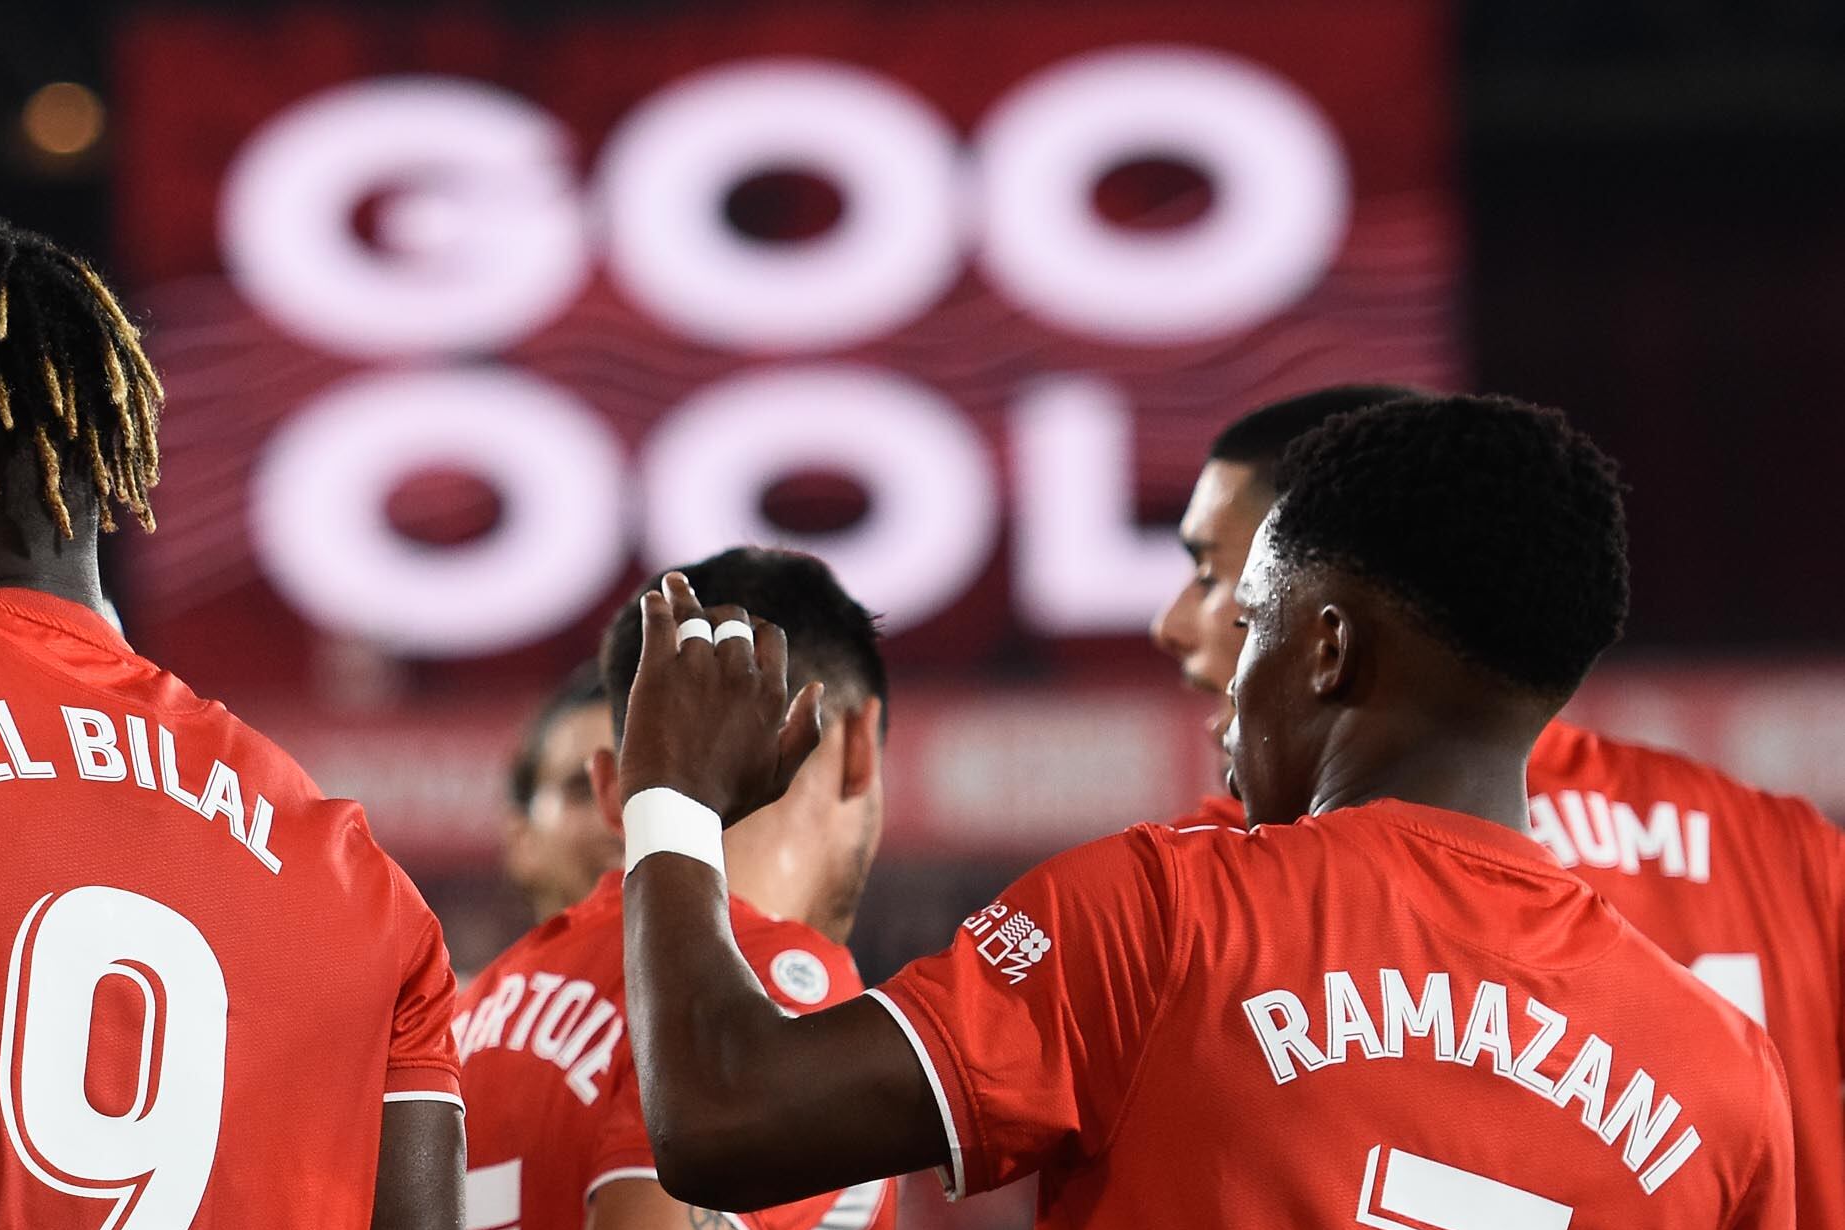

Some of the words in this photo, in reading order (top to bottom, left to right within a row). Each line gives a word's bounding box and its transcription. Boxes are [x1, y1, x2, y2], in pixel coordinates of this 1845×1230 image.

[218, 45, 1353, 360] GOO
[249, 366, 1195, 658] OOL
[60, 705, 283, 876] BILAL
[1241, 967, 1702, 1196] RAMAZANI
